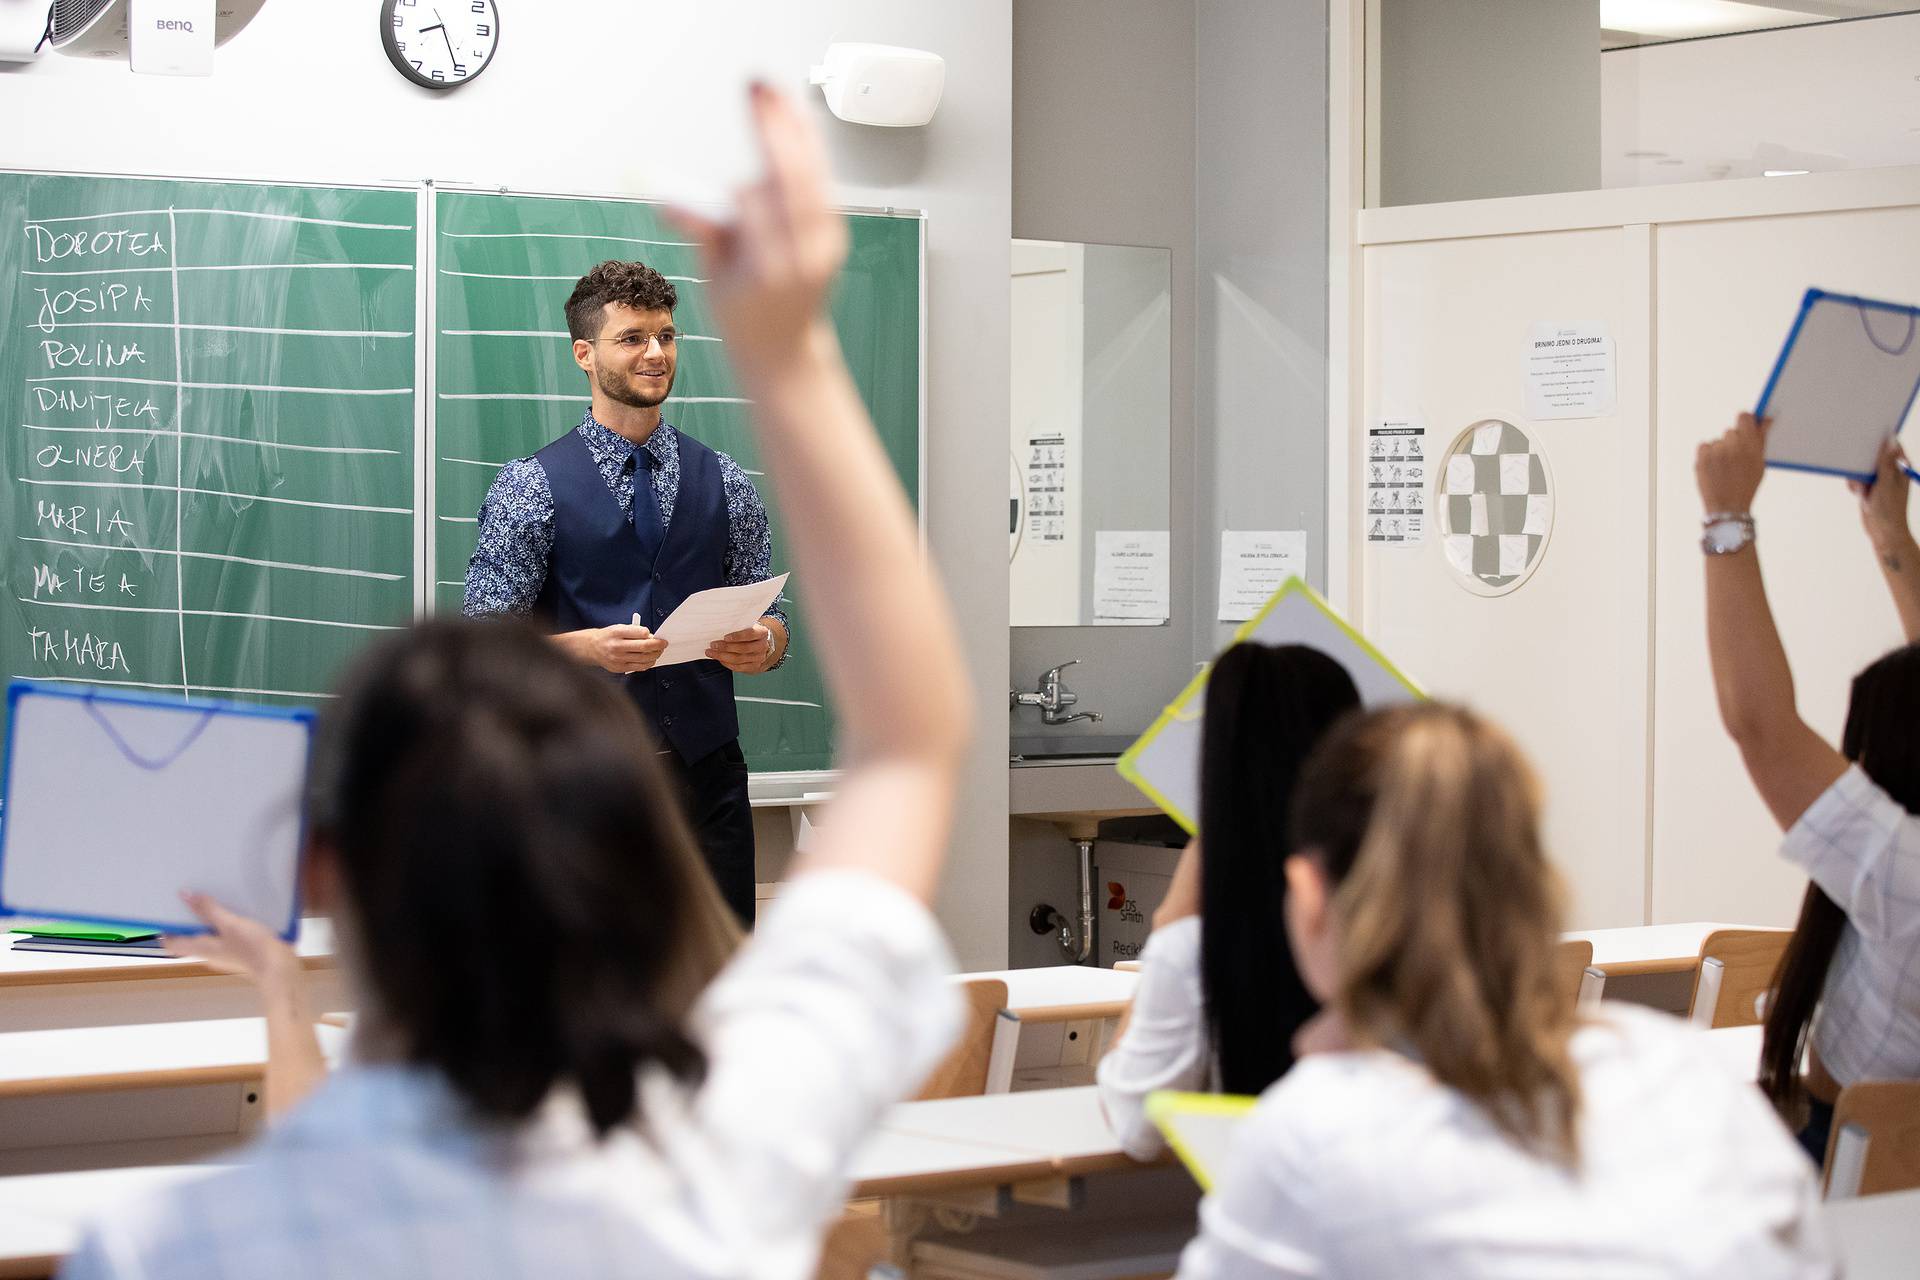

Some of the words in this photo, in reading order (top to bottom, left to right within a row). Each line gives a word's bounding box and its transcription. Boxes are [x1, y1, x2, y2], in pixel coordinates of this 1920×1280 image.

[471, 1, 485, 13] 2
[157, 20, 194, 33] BenQ
[476, 24, 490, 36] 3
[454, 64, 467, 77] 5
[24, 224, 168, 263] DOROTEA
[34, 282, 153, 334] JOSIPA
[39, 339, 146, 370] POLINA
[37, 500, 135, 537] MARIA
[1125, 900, 1137, 912] DS
[1120, 909, 1144, 924] Smith
